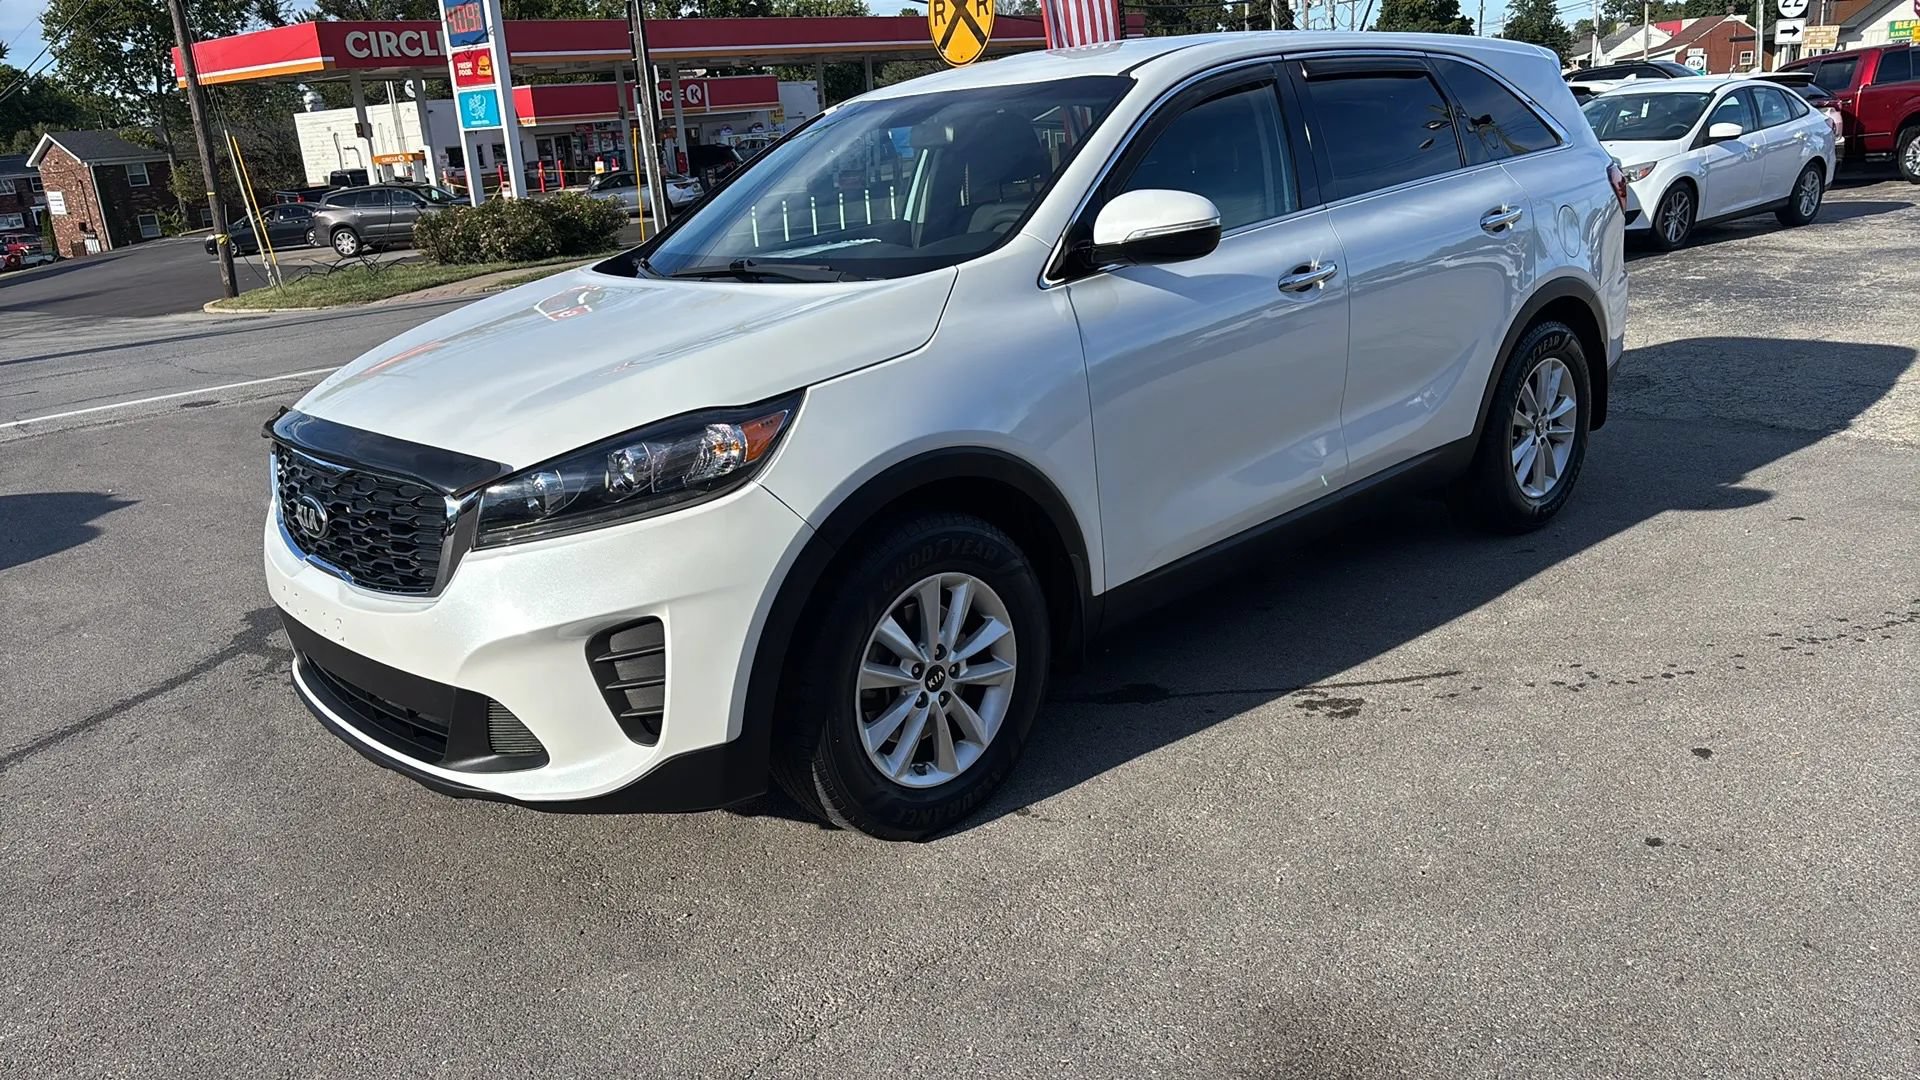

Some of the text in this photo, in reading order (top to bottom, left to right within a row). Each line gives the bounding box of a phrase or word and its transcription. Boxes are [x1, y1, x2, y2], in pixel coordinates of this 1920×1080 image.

[1687, 59, 1702, 67] 146
[298, 503, 320, 531] KIA
[927, 670, 944, 688] KIA
